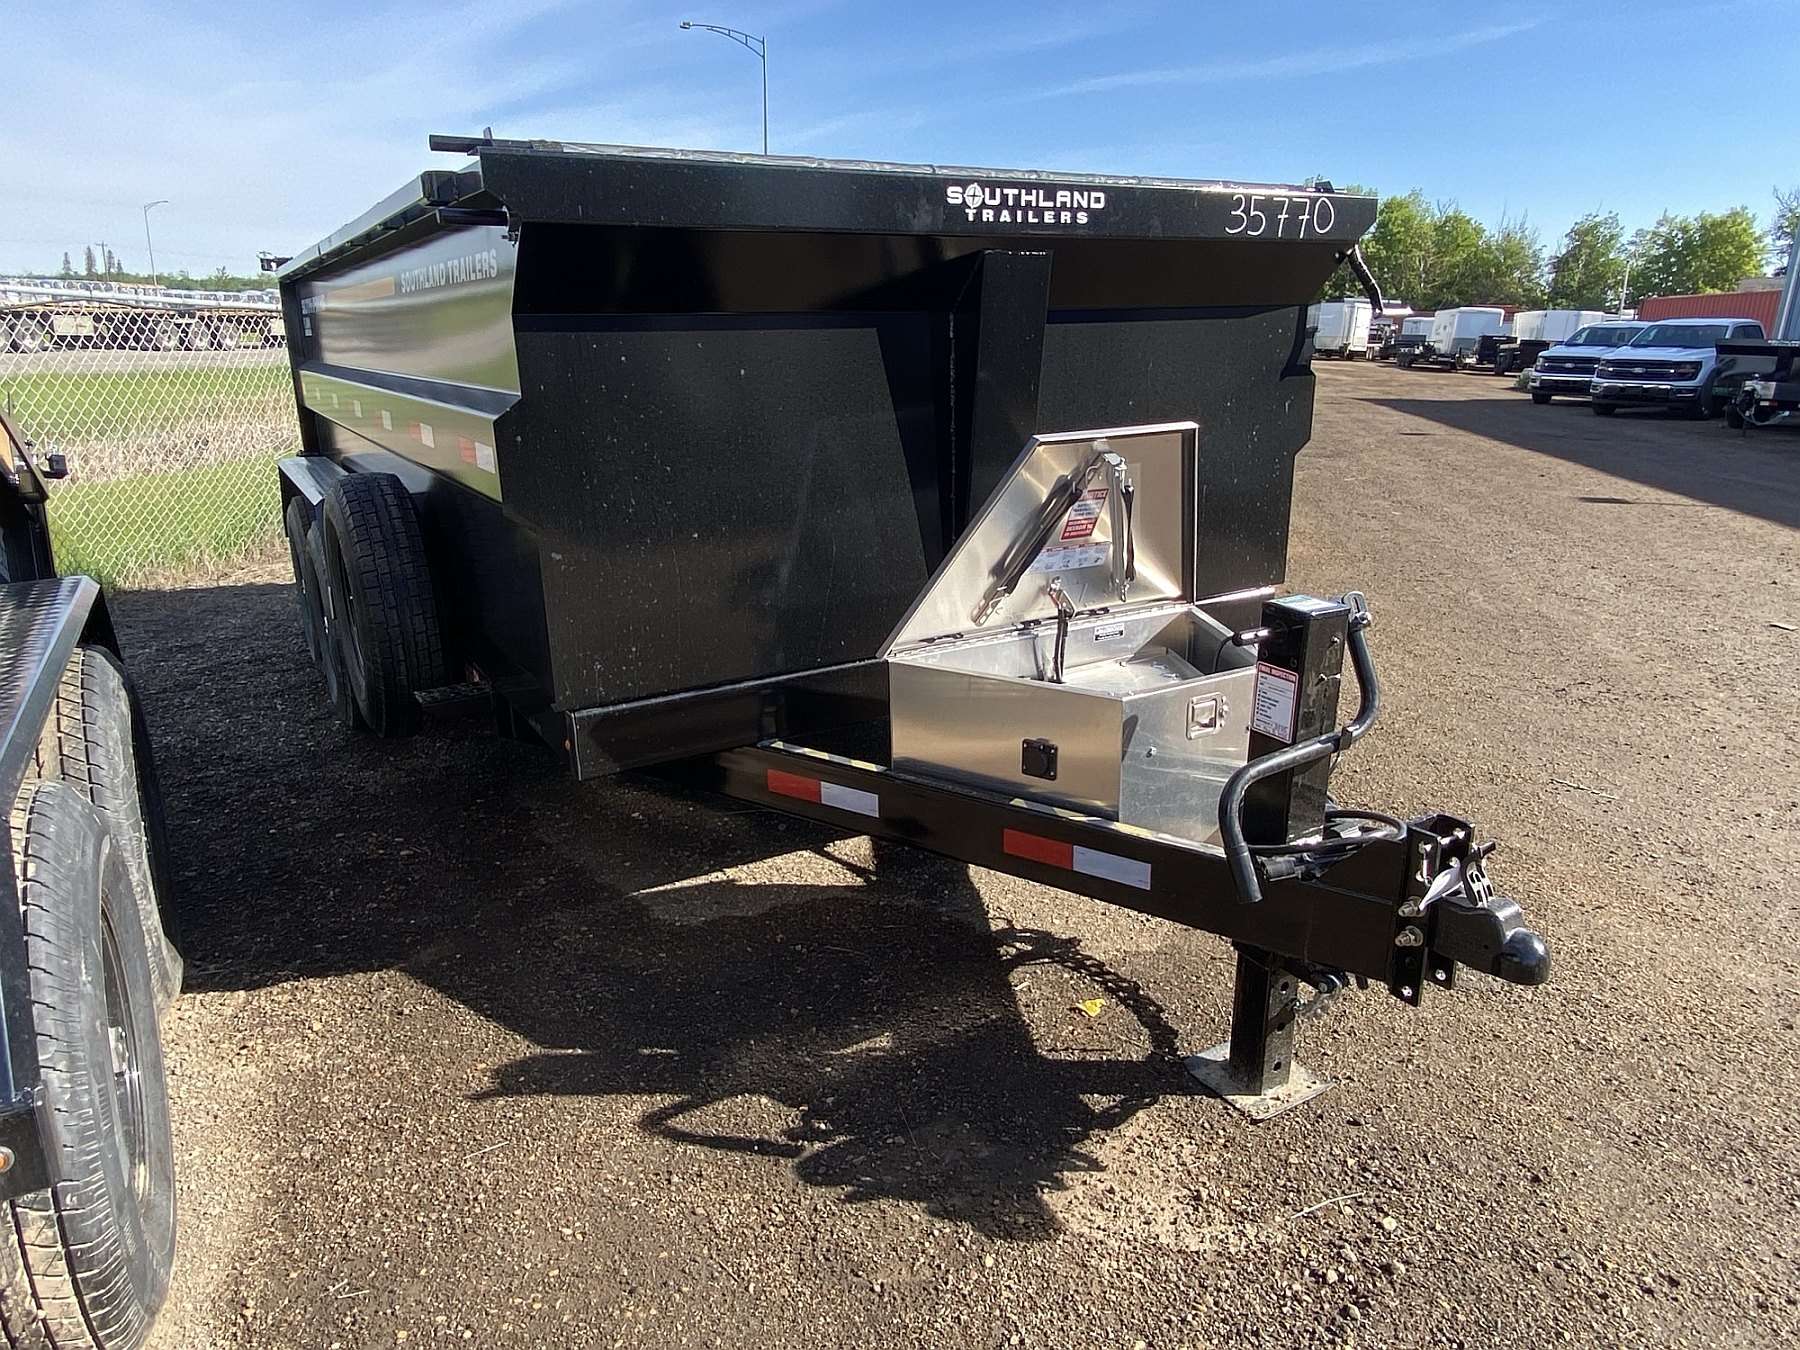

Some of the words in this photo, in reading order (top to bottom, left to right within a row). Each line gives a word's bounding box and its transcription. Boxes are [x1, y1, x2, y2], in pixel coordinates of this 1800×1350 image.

[946, 183, 1106, 209] SOUTHLAND
[965, 208, 1089, 224] TRAILERS
[1225, 194, 1335, 239] 35770
[401, 262, 446, 294] SOUTHLAND
[447, 248, 498, 285] TRAILERS
